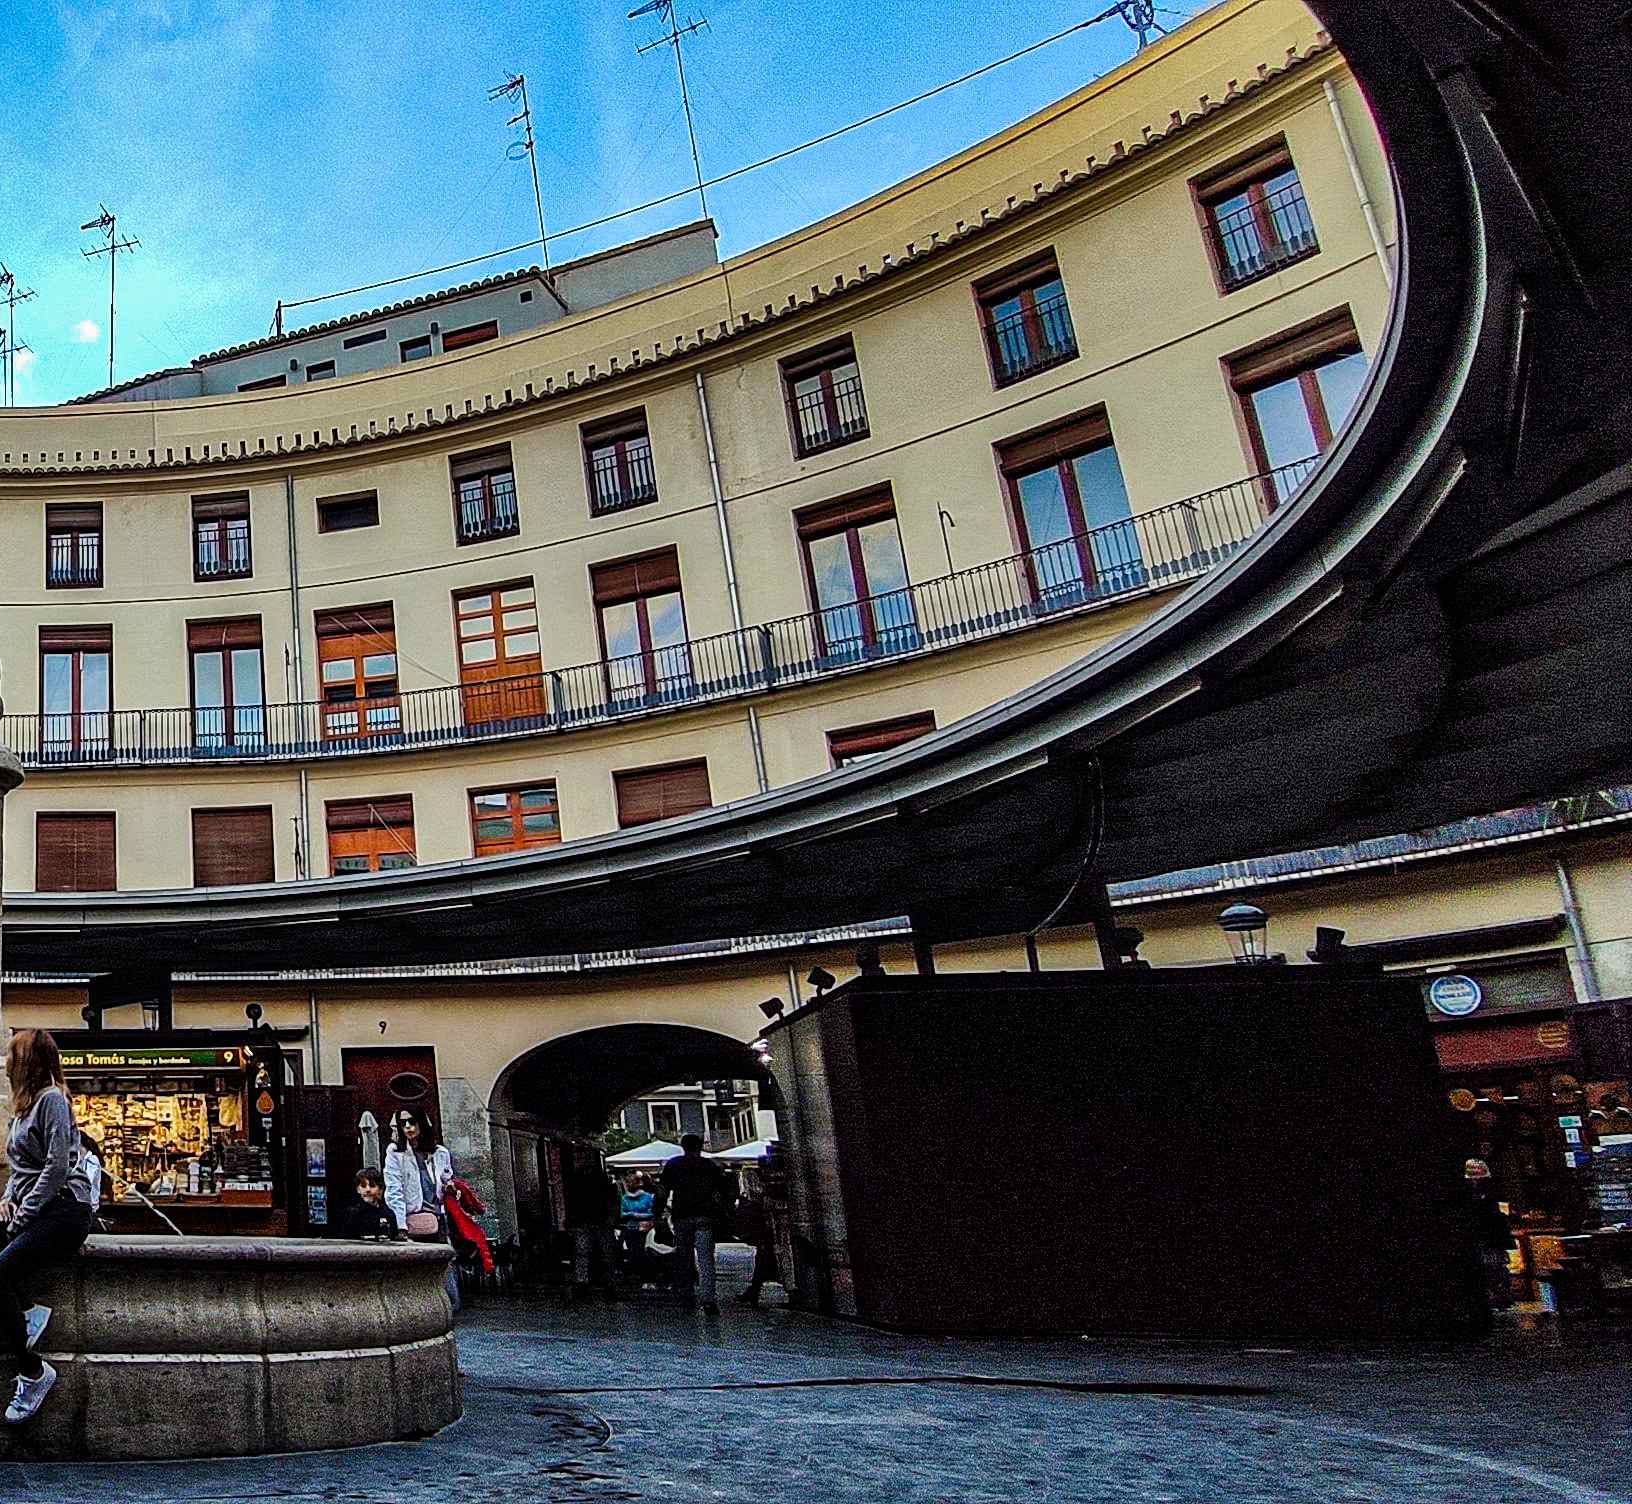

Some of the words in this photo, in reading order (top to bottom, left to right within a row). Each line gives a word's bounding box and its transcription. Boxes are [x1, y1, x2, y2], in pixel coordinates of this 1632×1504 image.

[378, 1020, 388, 1035] 9
[86, 1052, 126, 1066] Tomás
[223, 1050, 234, 1063] 9
